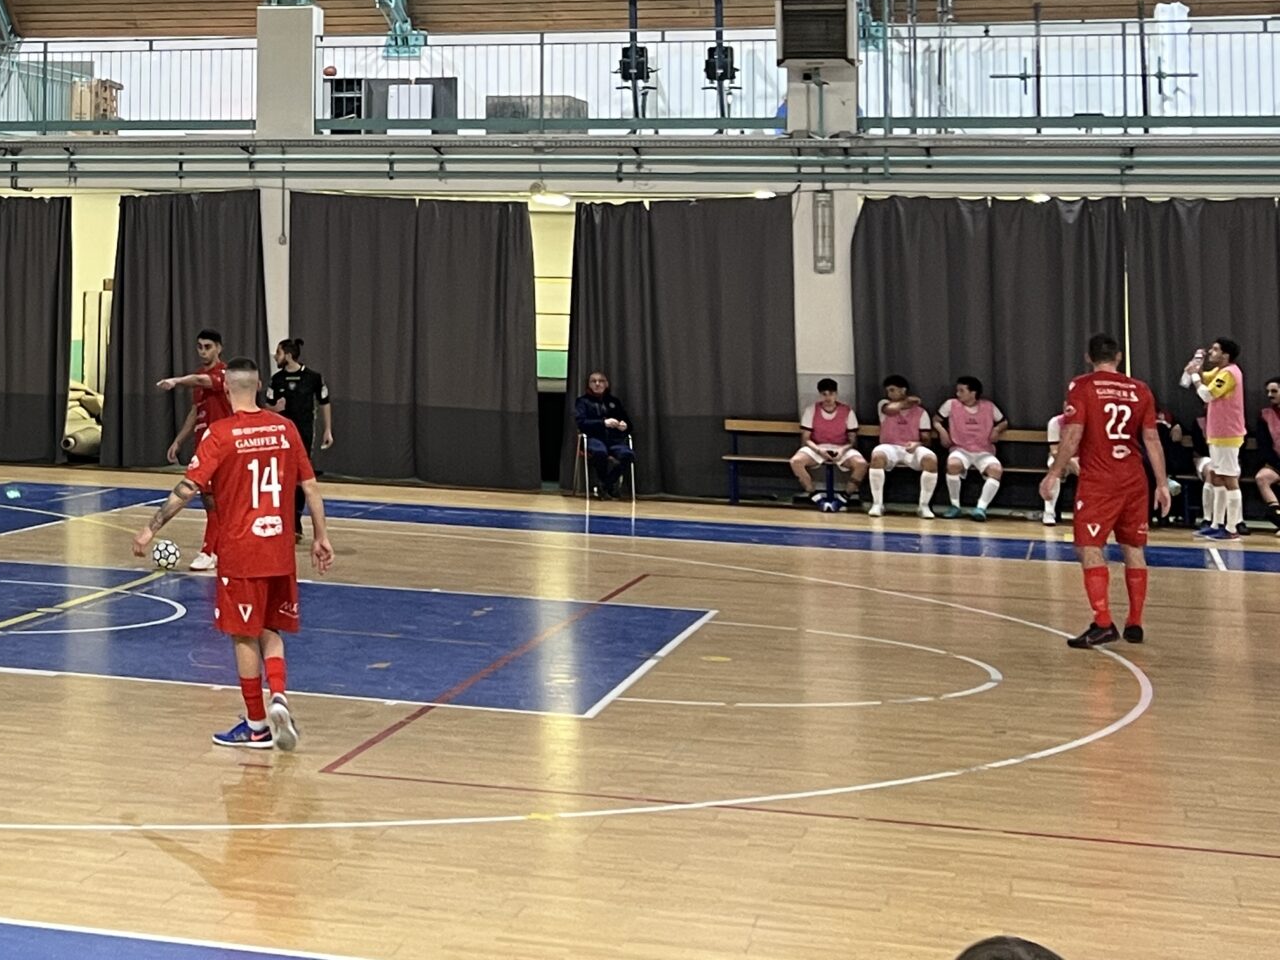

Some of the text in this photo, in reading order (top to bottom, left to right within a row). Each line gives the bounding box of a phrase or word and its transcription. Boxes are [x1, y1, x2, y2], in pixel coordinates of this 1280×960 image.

[1104, 403, 1132, 439] 22
[235, 436, 278, 449] GAMIFER
[247, 456, 282, 509] 14
